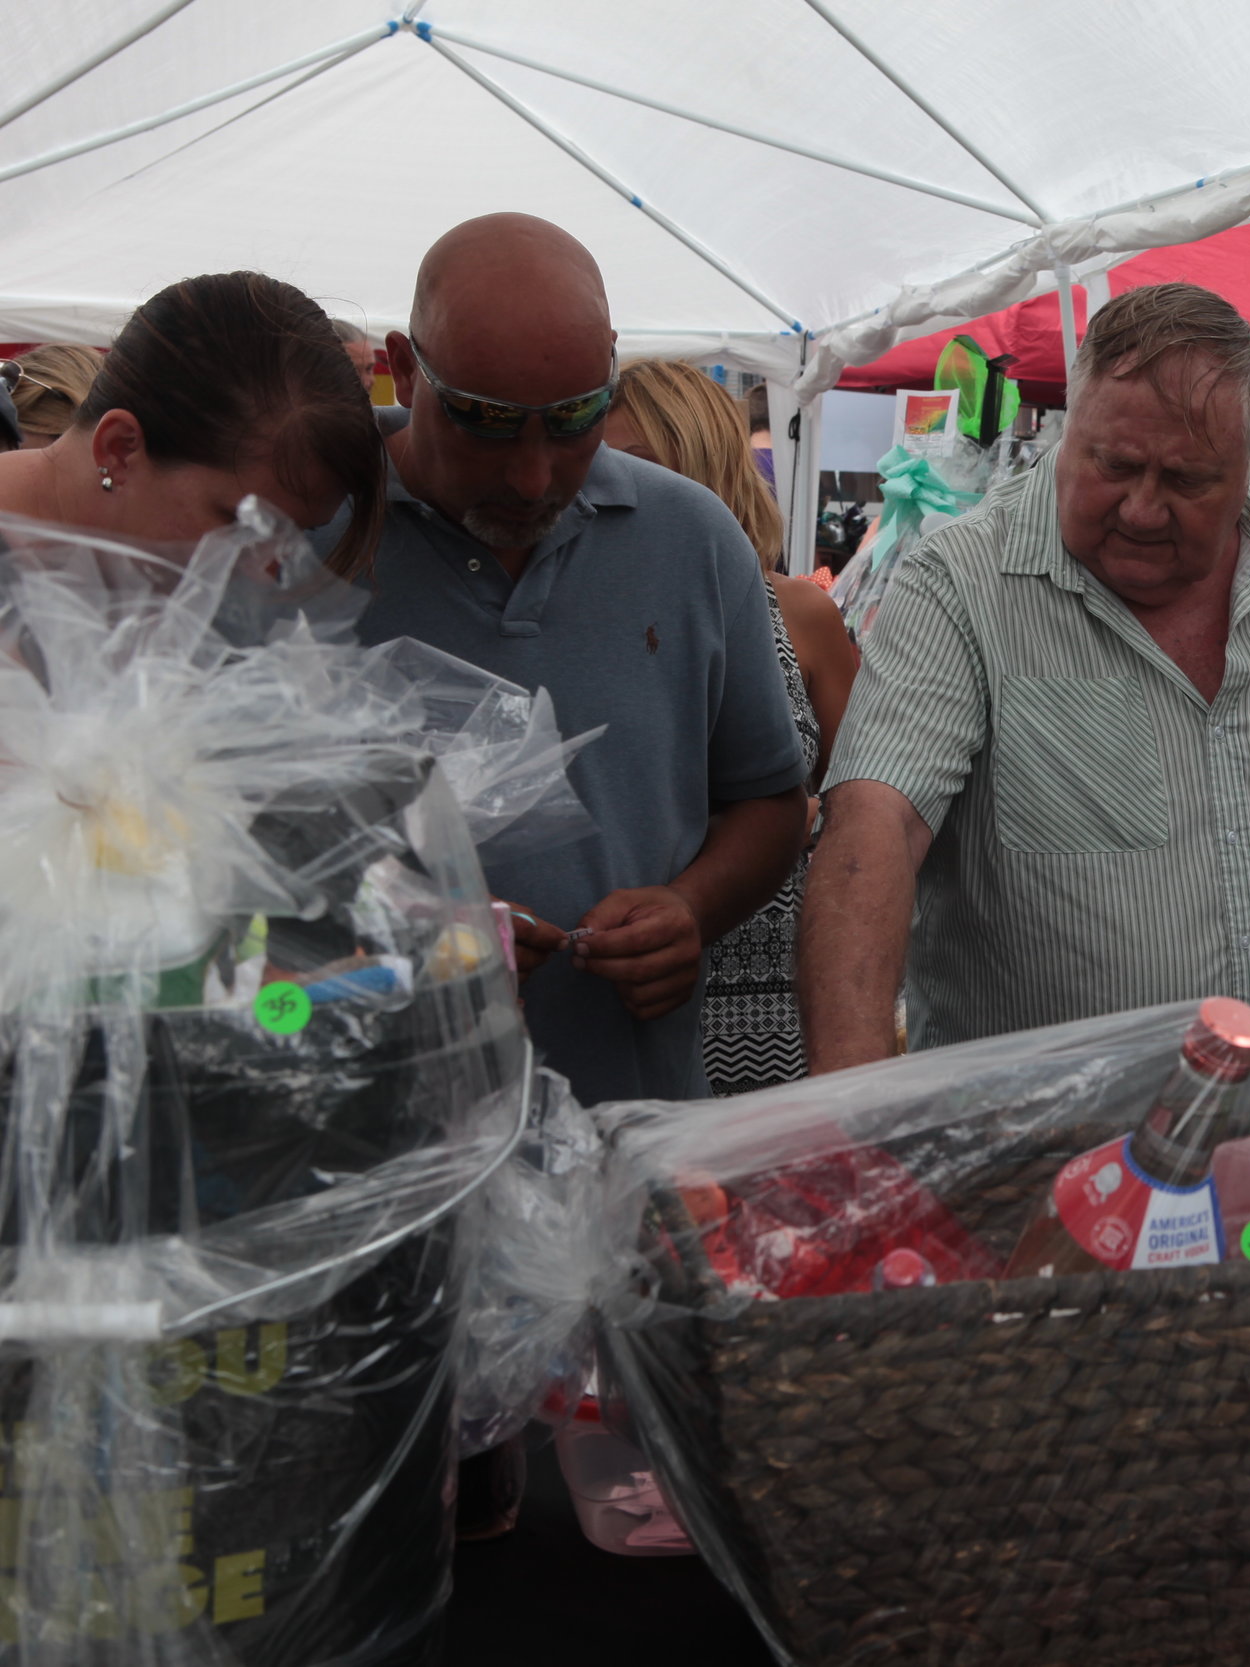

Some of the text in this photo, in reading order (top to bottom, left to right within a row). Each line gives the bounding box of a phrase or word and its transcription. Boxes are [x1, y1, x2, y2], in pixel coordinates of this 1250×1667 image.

[1149, 1209, 1210, 1231] AMERICA'S
[1149, 1226, 1209, 1250] ORIGINAL
[1147, 1250, 1181, 1264] CRAFT
